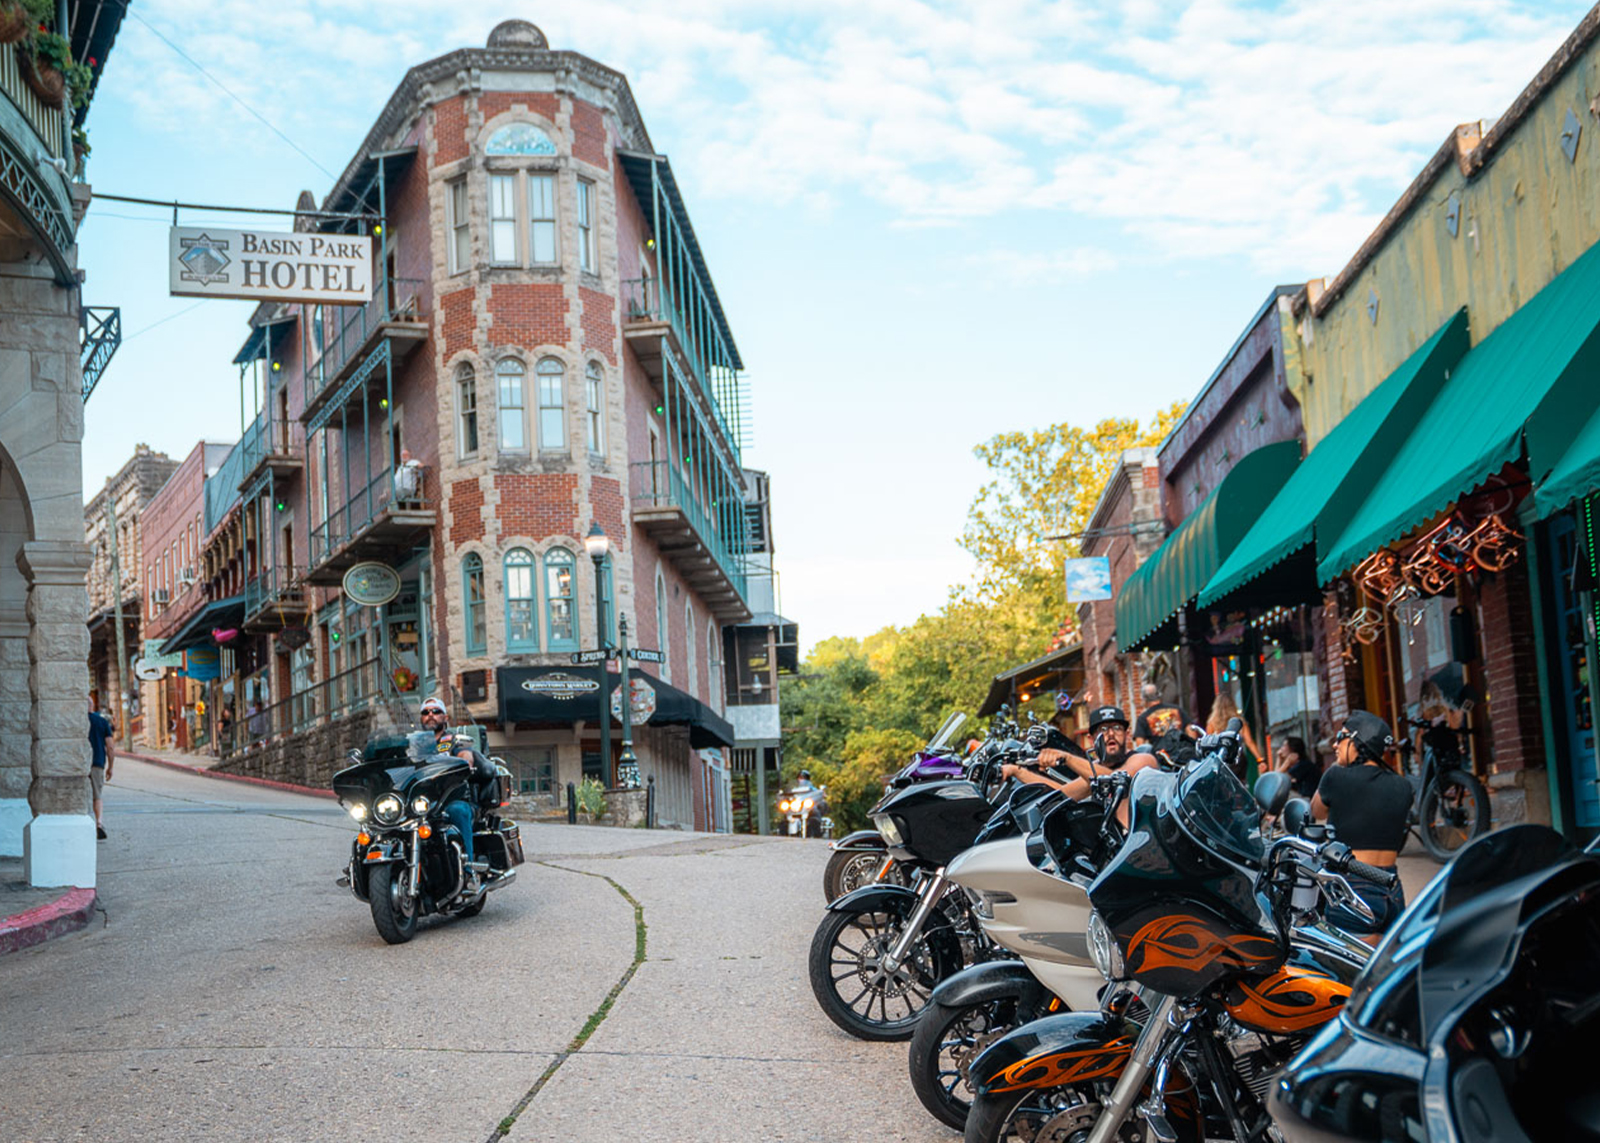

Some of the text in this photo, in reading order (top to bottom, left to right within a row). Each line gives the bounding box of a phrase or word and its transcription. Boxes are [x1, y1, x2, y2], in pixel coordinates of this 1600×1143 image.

[242, 233, 364, 259] BASIN PARK
[241, 259, 365, 292] HOTEL
